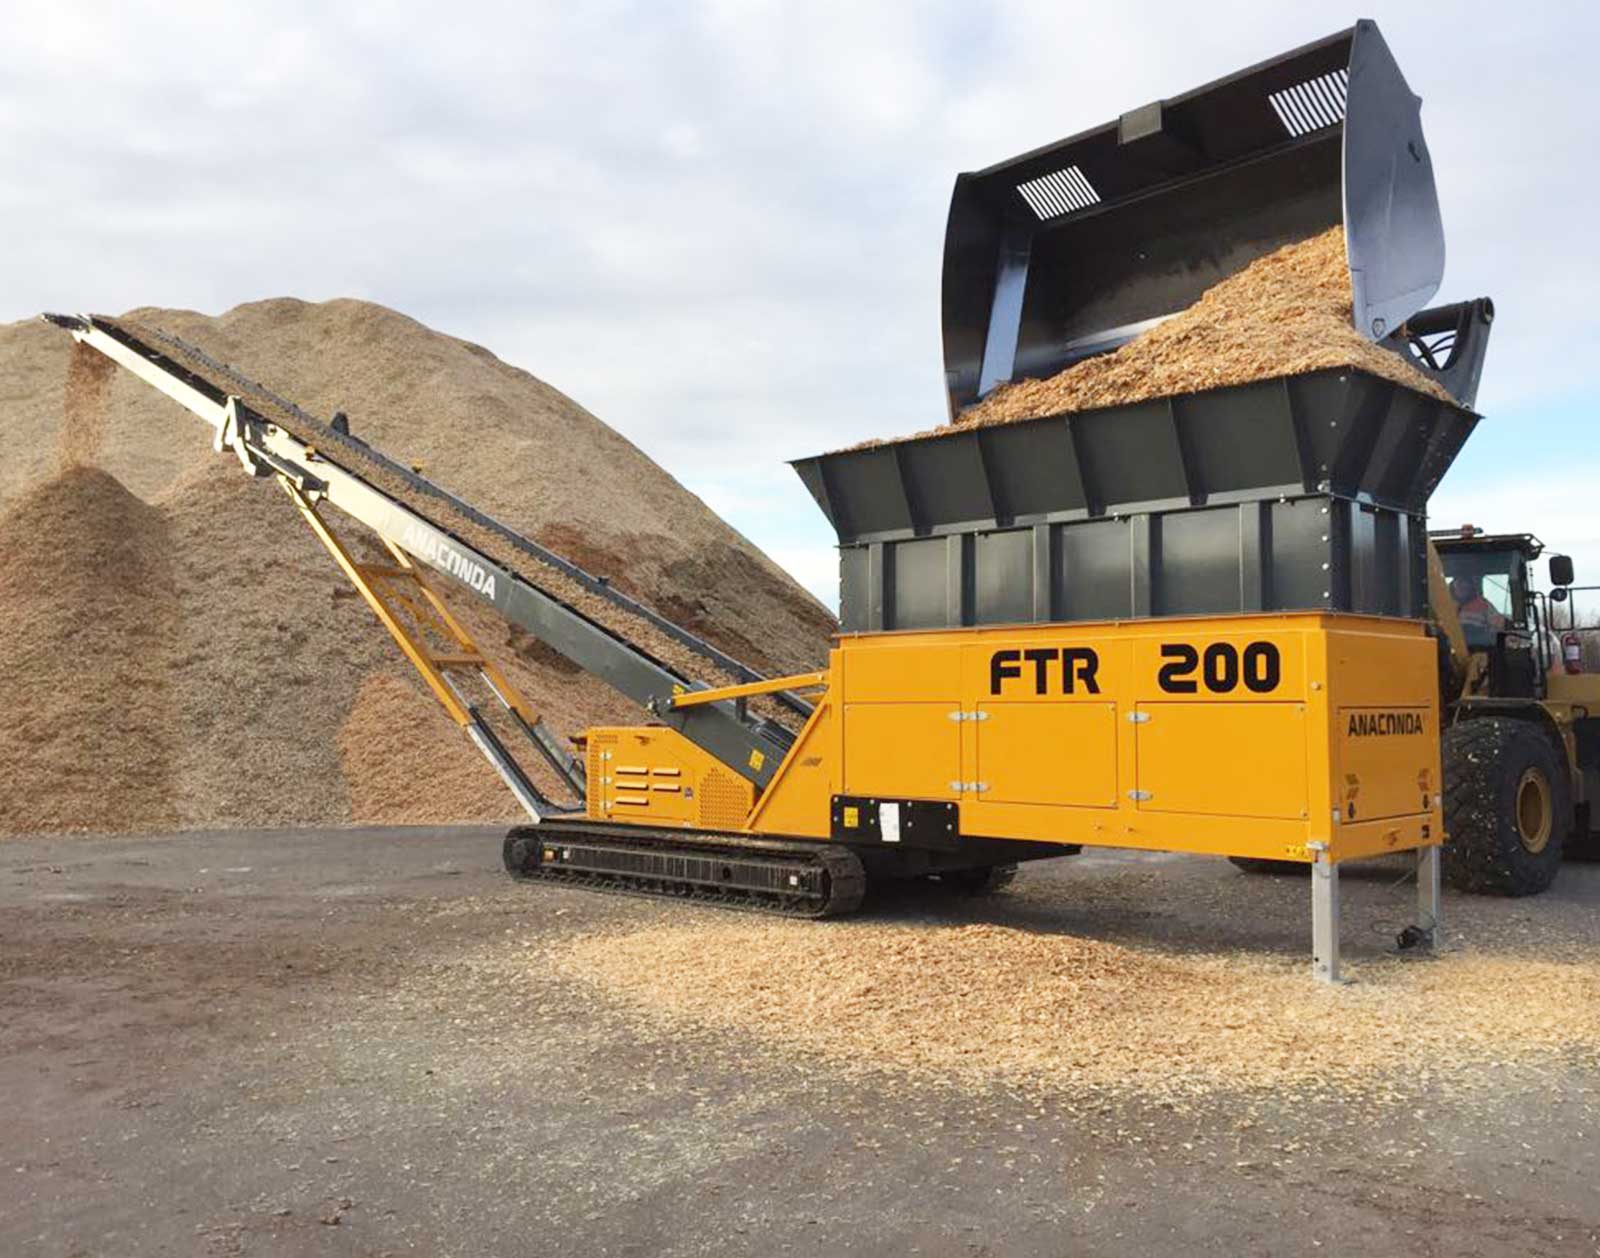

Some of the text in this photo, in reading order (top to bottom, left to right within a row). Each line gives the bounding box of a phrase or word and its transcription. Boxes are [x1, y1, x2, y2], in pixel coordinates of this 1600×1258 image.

[404, 522, 495, 601] ANACONDA
[990, 641, 1281, 695] FTR 200
[1348, 712, 1424, 737] ANACONDA
